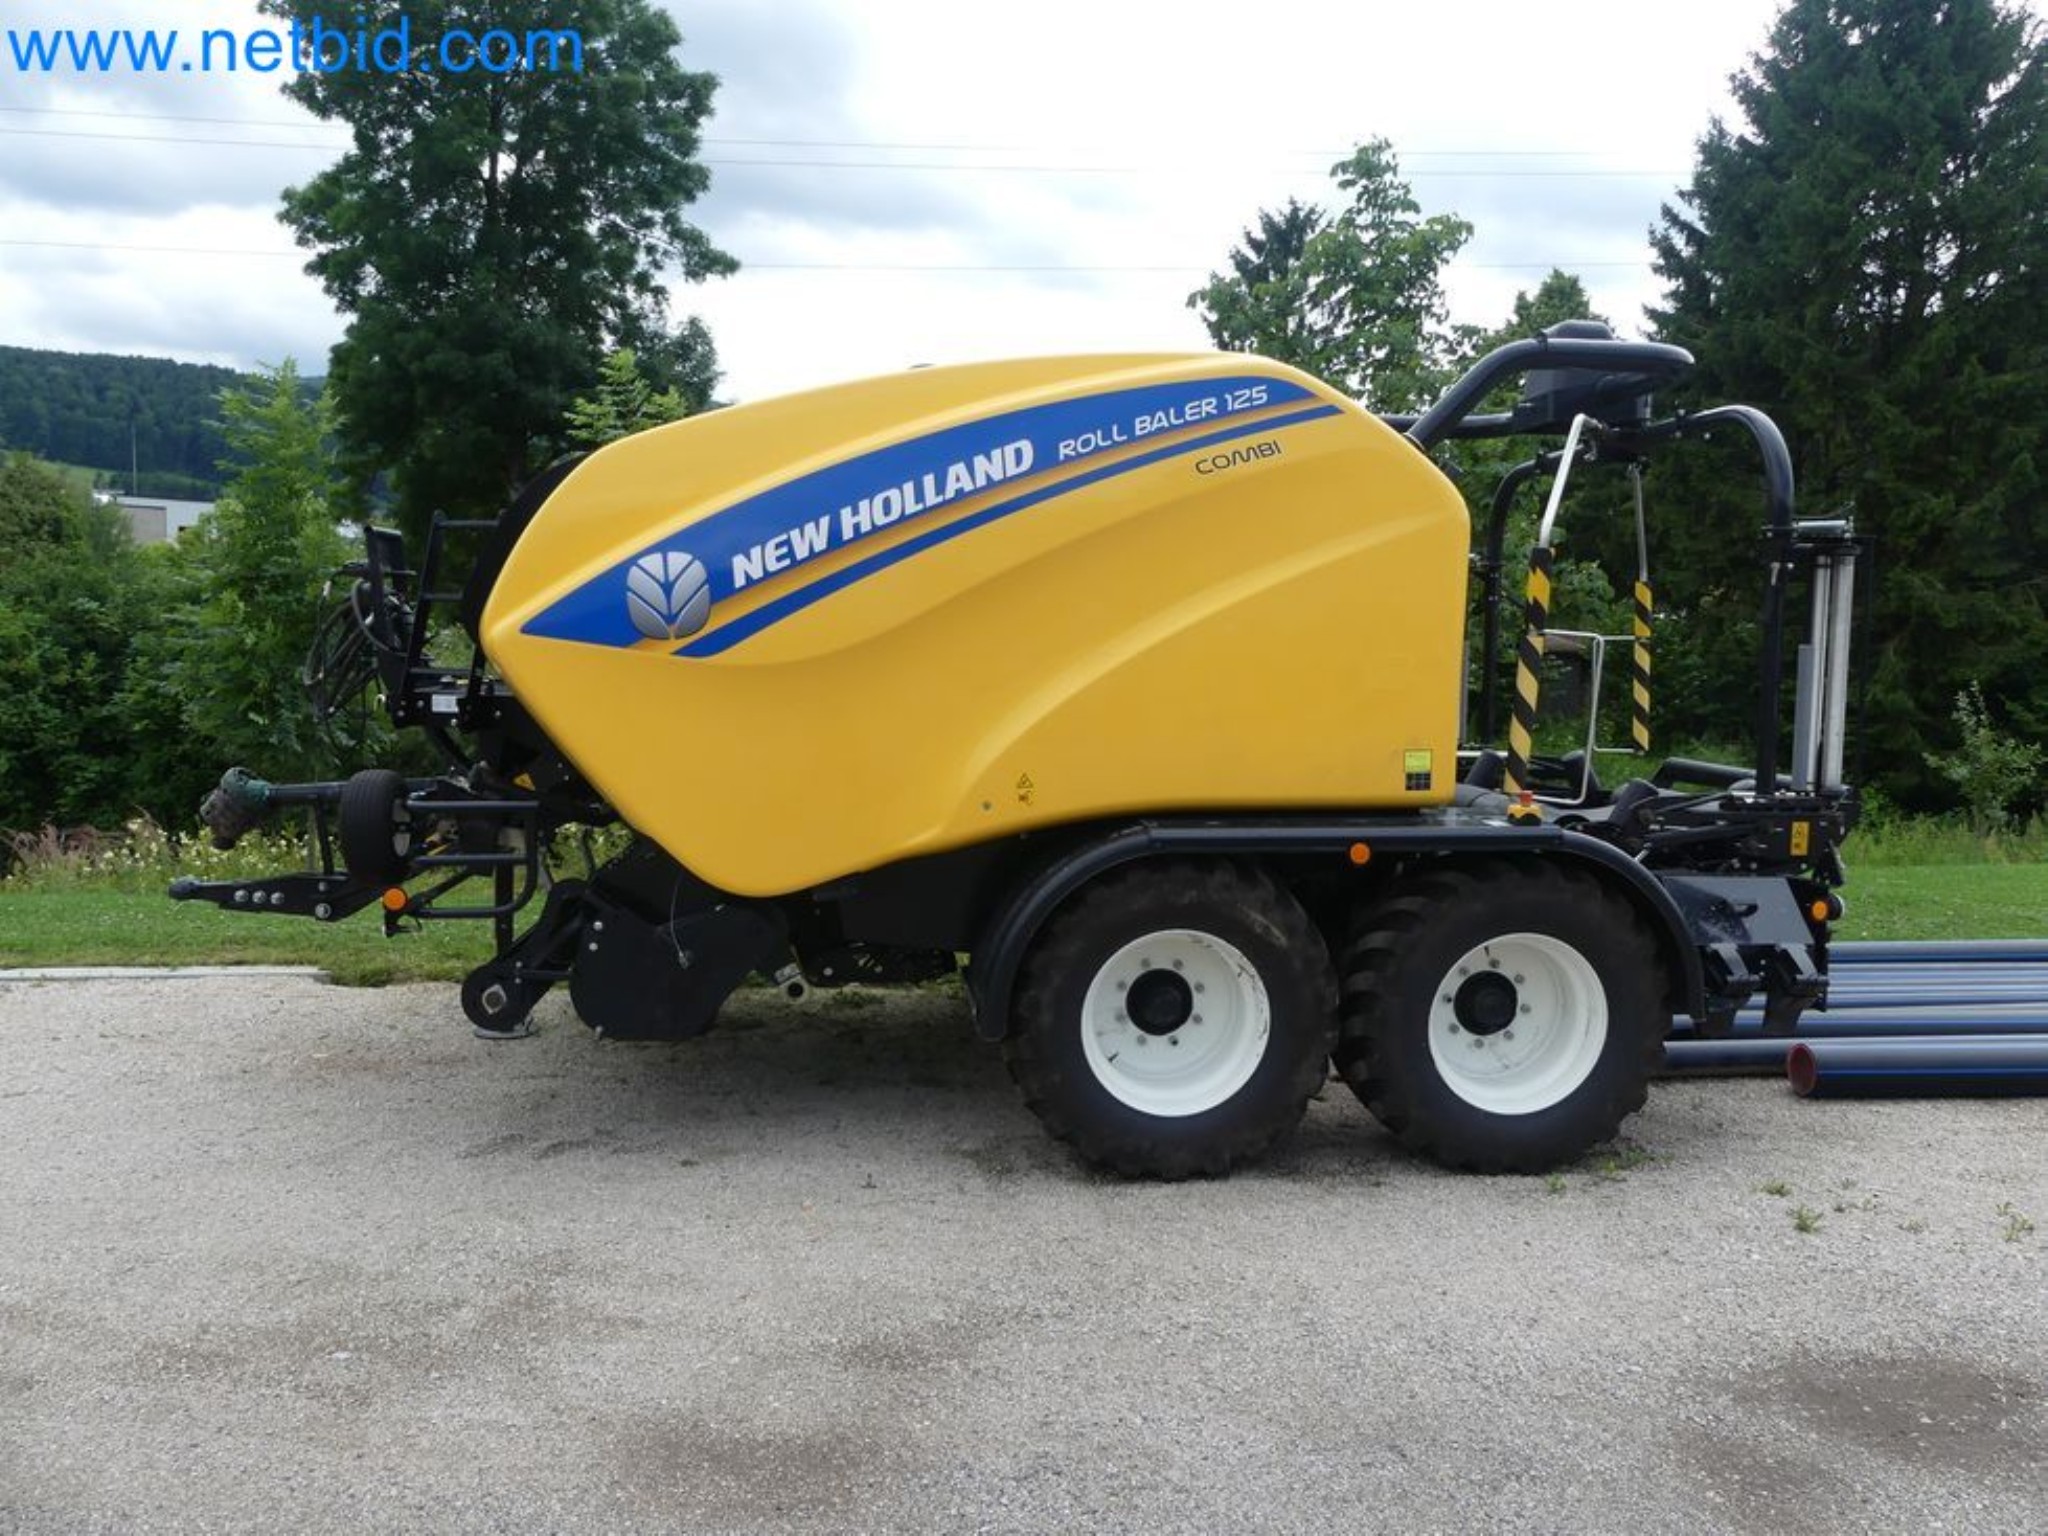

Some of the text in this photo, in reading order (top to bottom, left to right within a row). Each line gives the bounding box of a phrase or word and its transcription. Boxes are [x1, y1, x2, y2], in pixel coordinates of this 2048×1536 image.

[731, 385, 1269, 590] NEW HOLLAND ROLL BALER 125
[1194, 439, 1282, 475] COMBI
